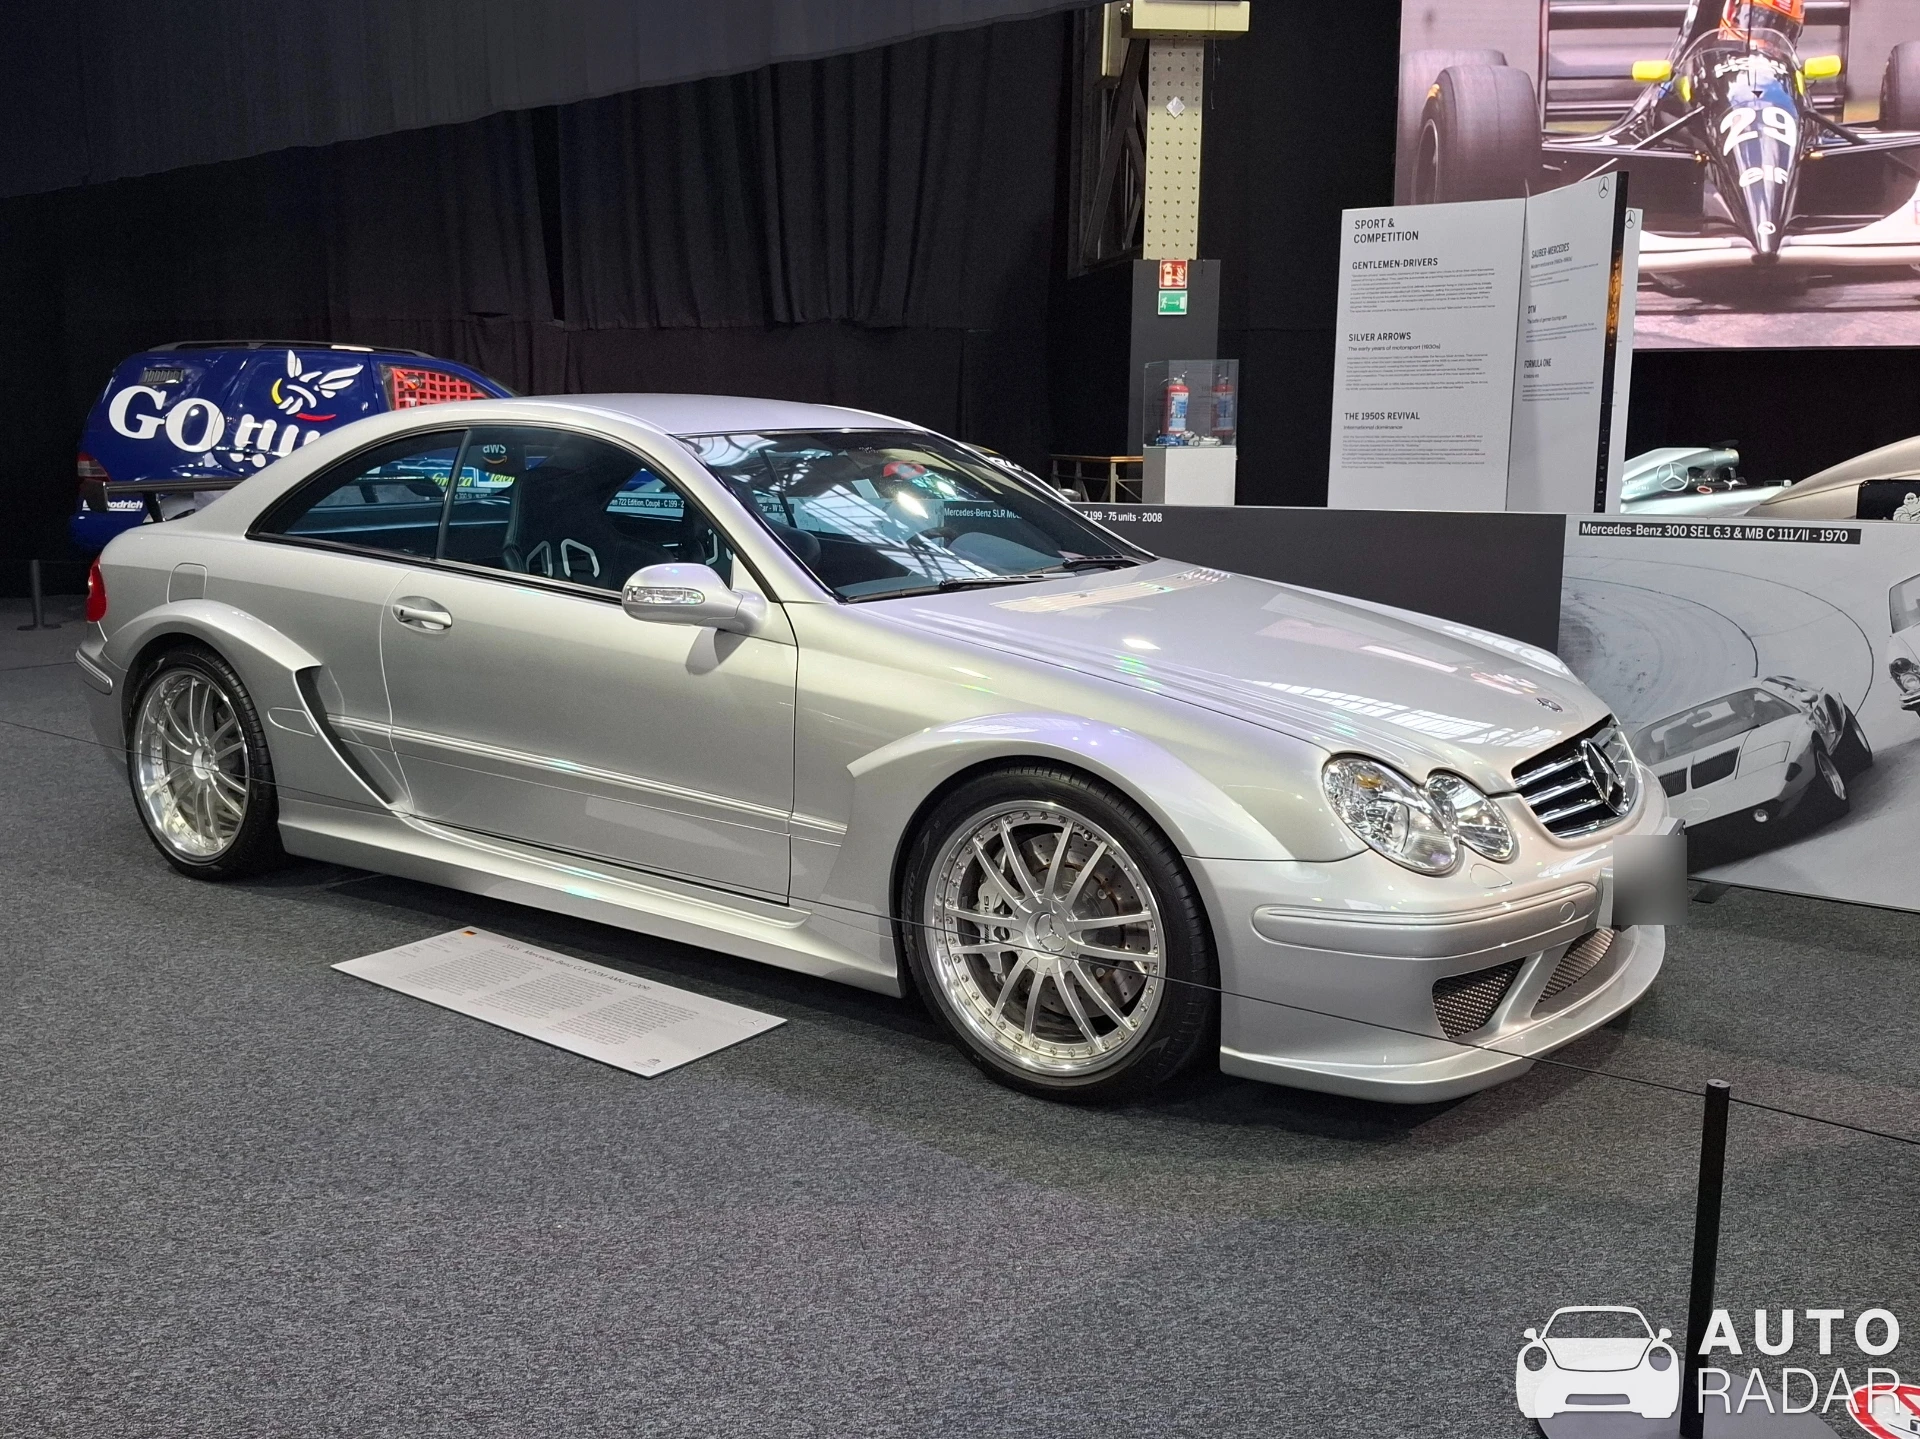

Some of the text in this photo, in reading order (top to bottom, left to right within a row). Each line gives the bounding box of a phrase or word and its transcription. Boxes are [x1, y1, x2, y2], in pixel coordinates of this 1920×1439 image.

[1720, 106, 1797, 156] 29
[1354, 218, 1395, 229] SPORT &
[1353, 230, 1419, 244] COMPETITION
[1531, 242, 1570, 259] SAUBER-MERCEDES
[1352, 257, 1438, 270] GENTLEMEN-DRIVERS
[1527, 304, 1537, 314] DTM
[1348, 332, 1412, 342] SILVER ARROWS
[1392, 344, 1421, 352] motorsport
[1543, 358, 1552, 367] ONE
[108, 385, 224, 453] GO
[1344, 411, 1420, 420] THE 1950S REVIVAL
[618, 498, 626, 506] 722
[669, 500, 677, 508] 199
[944, 507, 991, 517] Mercedes-Benz
[993, 509, 1006, 518] SLR
[1108, 511, 1117, 521] 75
[1118, 512, 1136, 521] units
[1142, 512, 1163, 522] 2008
[1581, 523, 1663, 537] Mercedes-Benz
[1664, 525, 1687, 537] 300
[1689, 526, 1711, 538] SEL
[1713, 527, 1731, 538] 6.3
[1733, 527, 1743, 539] &
[1745, 528, 1764, 540] MB
[1766, 528, 1775, 540] C
[1777, 528, 1810, 541] 111/II
[1819, 529, 1849, 543] 1970
